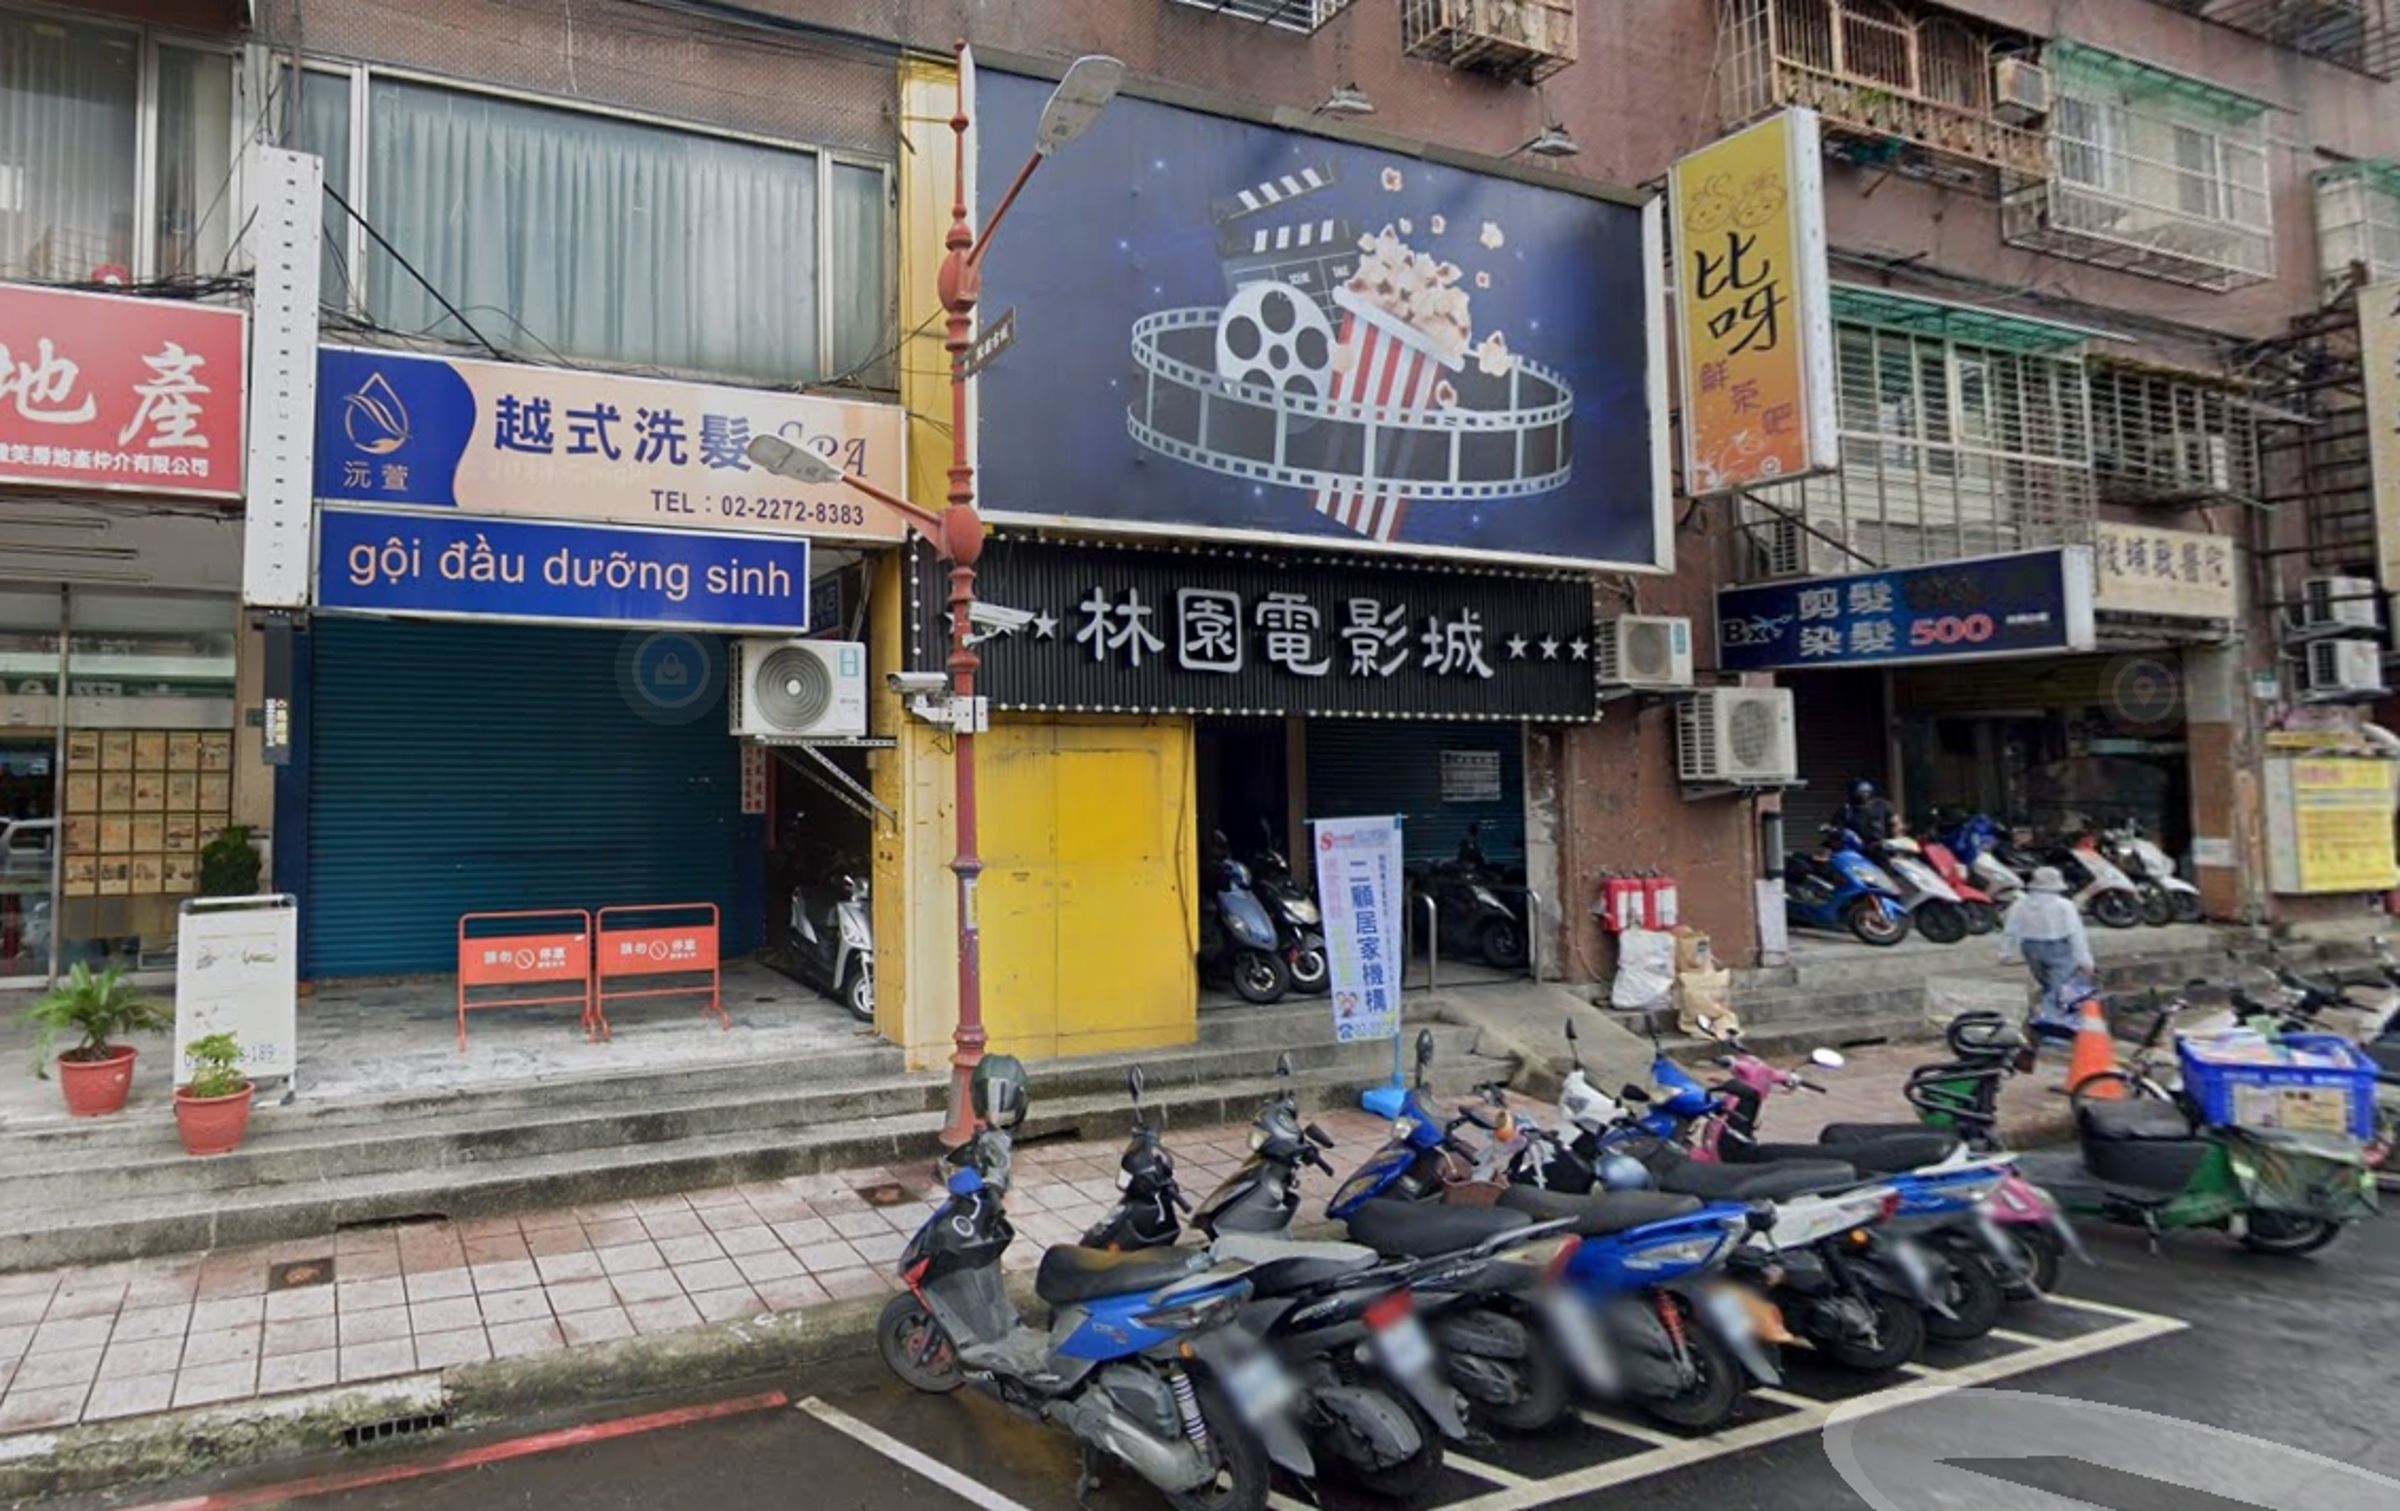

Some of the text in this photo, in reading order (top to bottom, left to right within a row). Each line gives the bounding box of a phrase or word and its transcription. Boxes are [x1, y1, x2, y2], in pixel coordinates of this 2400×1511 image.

[1695, 231, 1787, 356] 比呀
[494, 393, 754, 472] 越式洗髮
[721, 494, 865, 527] 02-2272-8383
[347, 532, 792, 602] gội đầu dưỡng sinh
[1076, 586, 1494, 679] 林園電影城
[1908, 613, 1994, 646] 500
